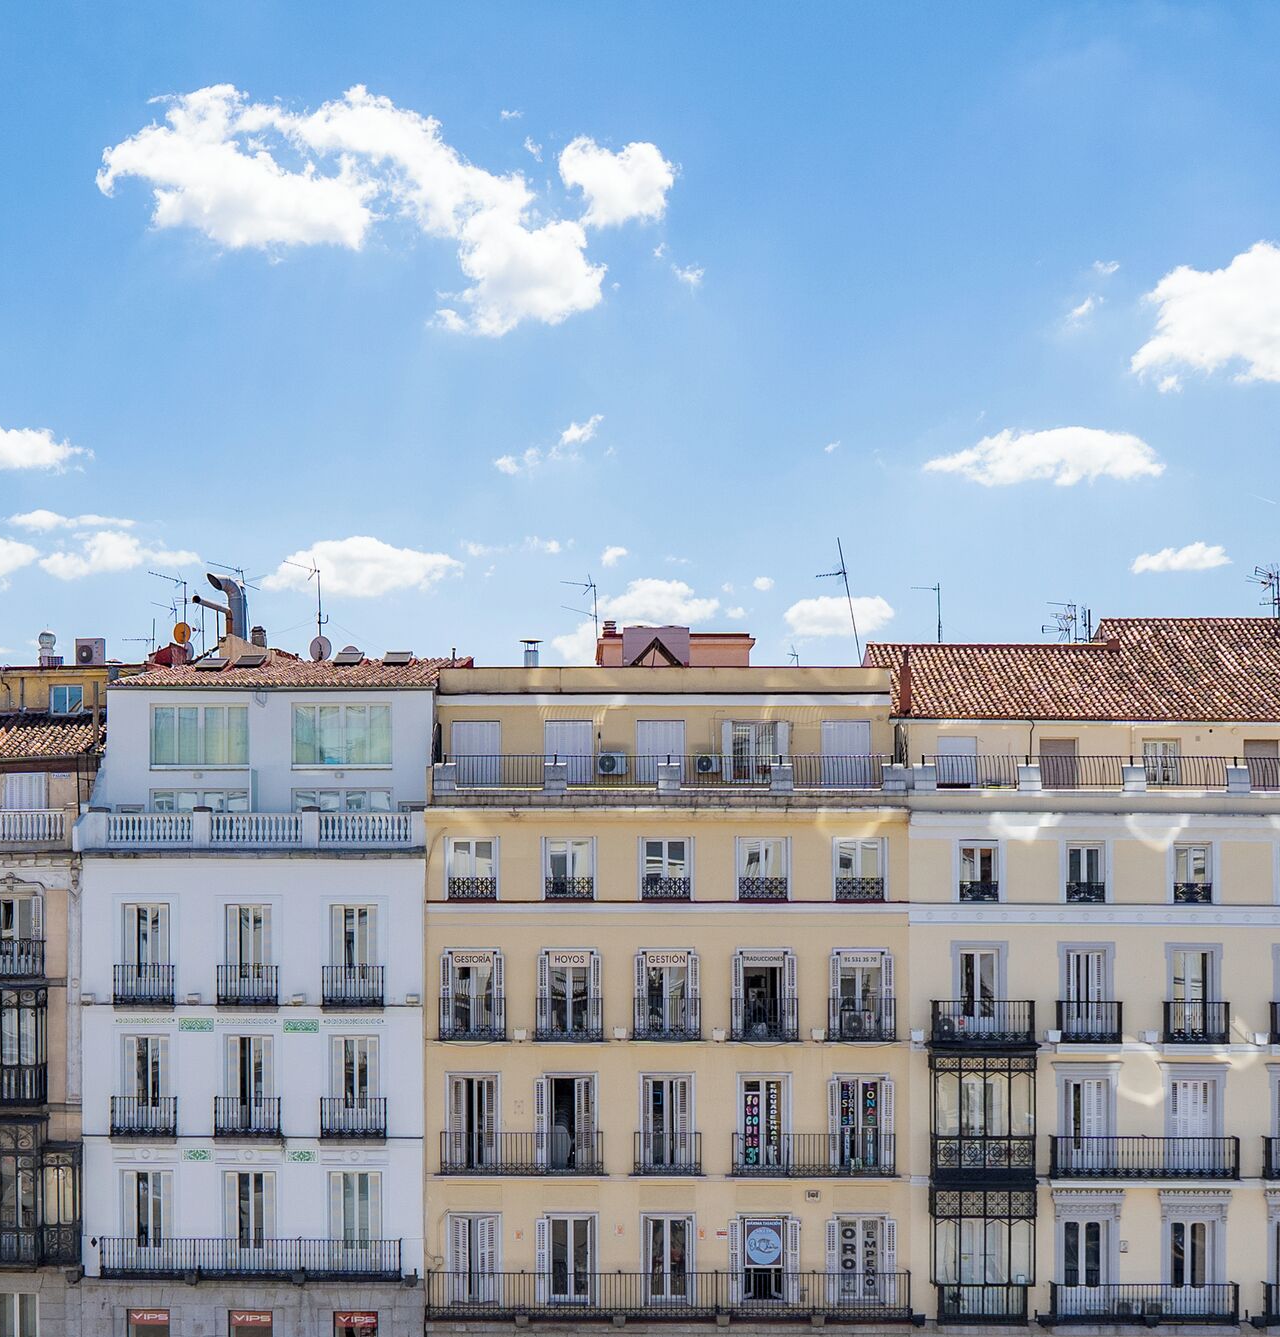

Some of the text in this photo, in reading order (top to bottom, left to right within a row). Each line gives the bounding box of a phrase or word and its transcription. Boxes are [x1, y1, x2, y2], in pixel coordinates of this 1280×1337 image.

[454, 953, 491, 964] GESTORÍA
[554, 955, 585, 964] HOYOS
[648, 954, 686, 964] GESTIÓN
[841, 1228, 857, 1271] ORO
[864, 1231, 877, 1287] EMPEÑO
[130, 1312, 169, 1321] VIPS
[233, 1314, 272, 1323] VIPS
[338, 1315, 377, 1324] VIPS
